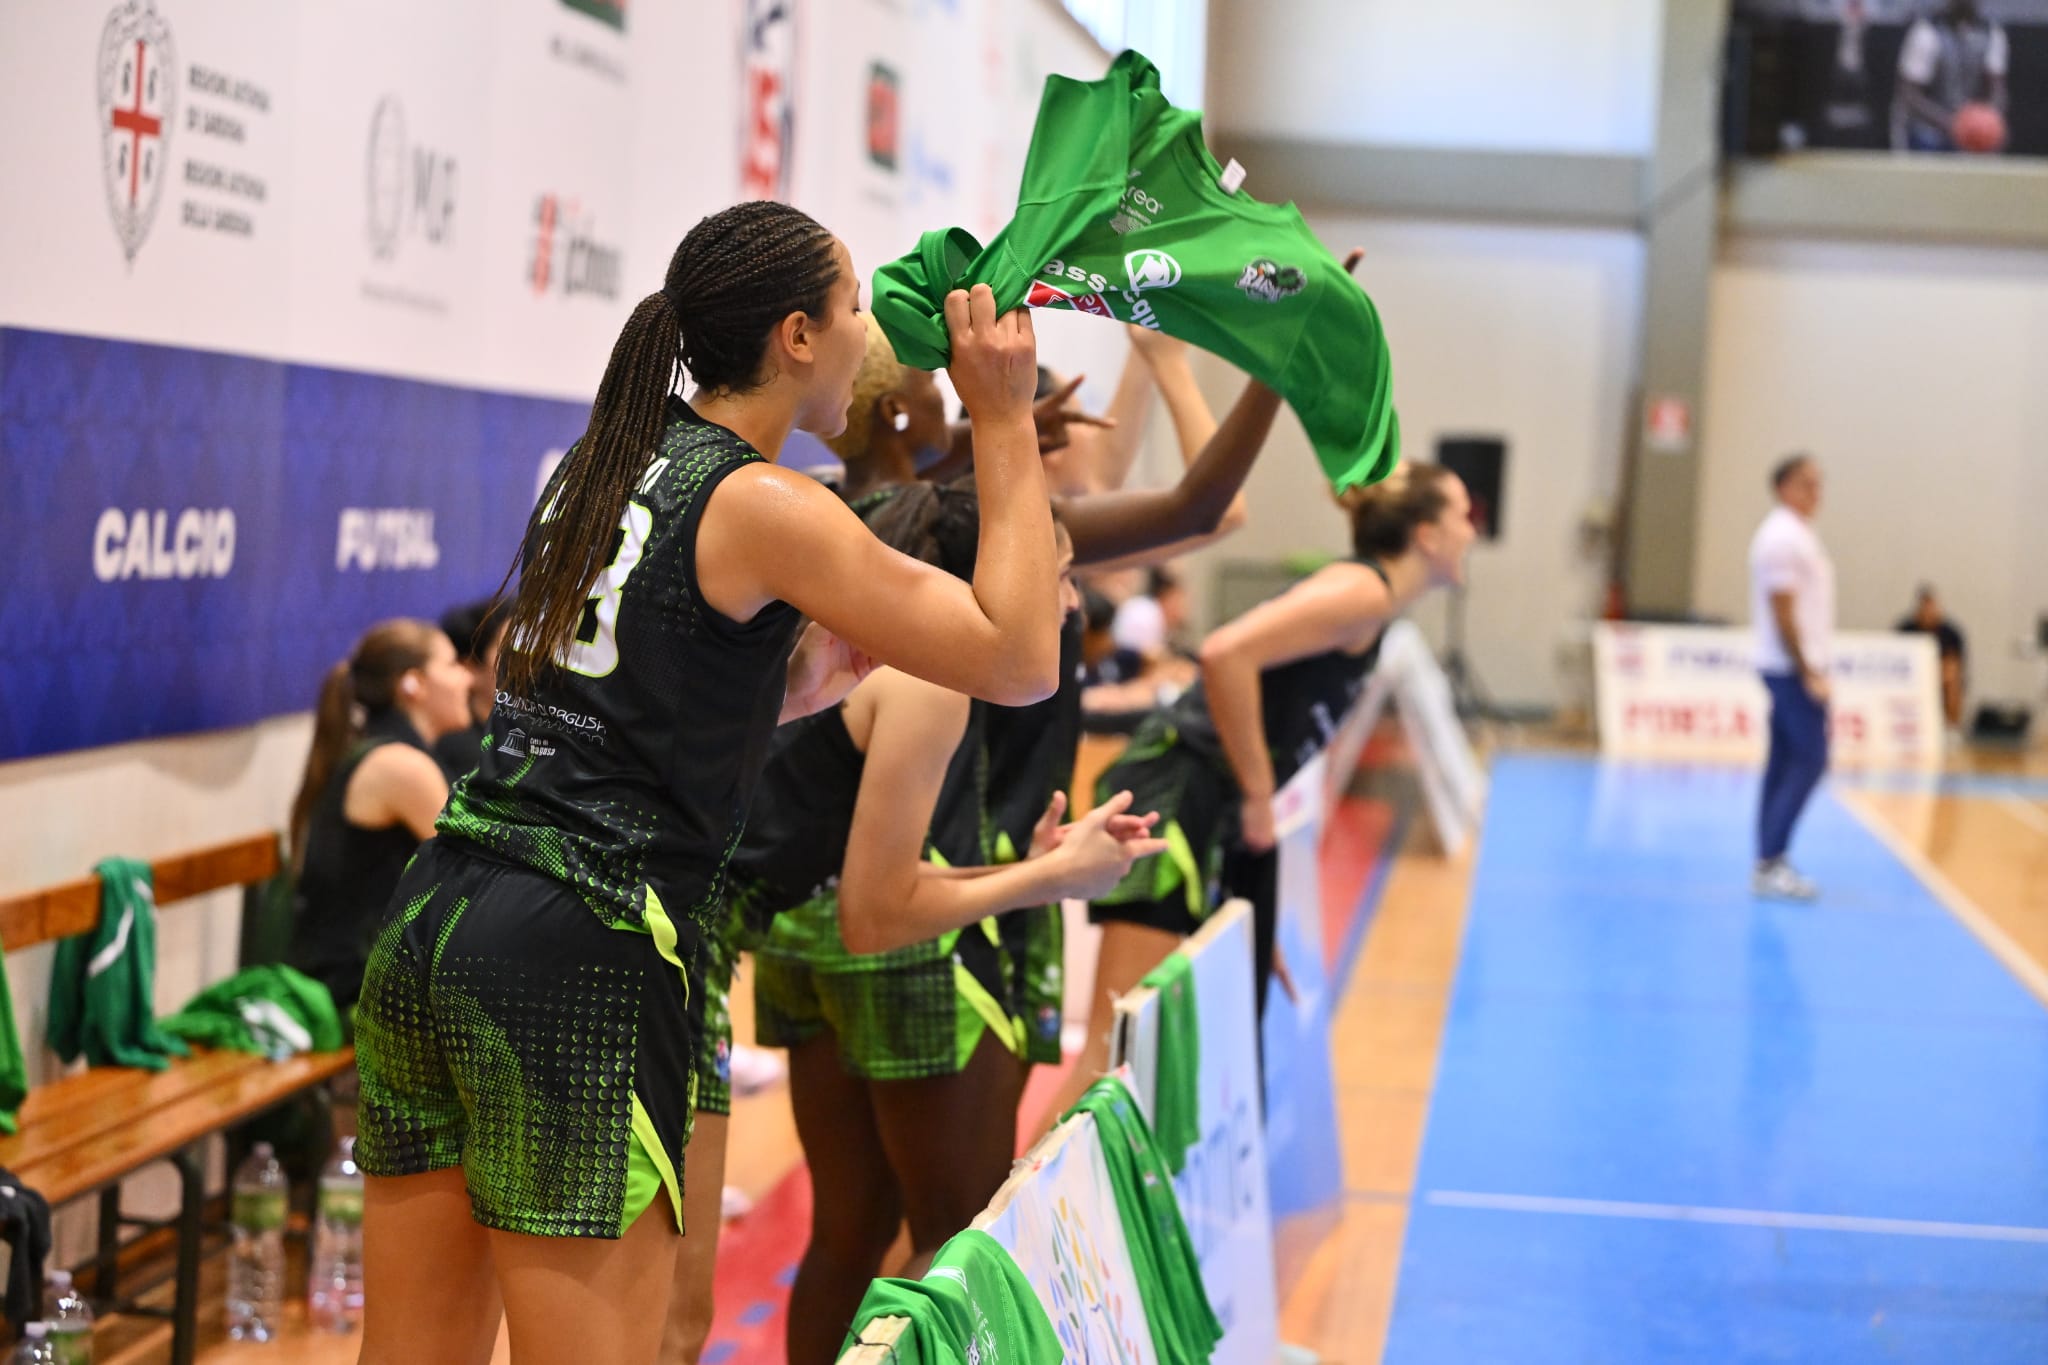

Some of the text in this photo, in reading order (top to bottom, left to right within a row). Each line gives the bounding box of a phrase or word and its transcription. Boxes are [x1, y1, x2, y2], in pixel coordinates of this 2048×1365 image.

[94, 507, 236, 581] CALCIO
[336, 508, 439, 571] FUTSAL
[530, 745, 556, 757] Ragusa
